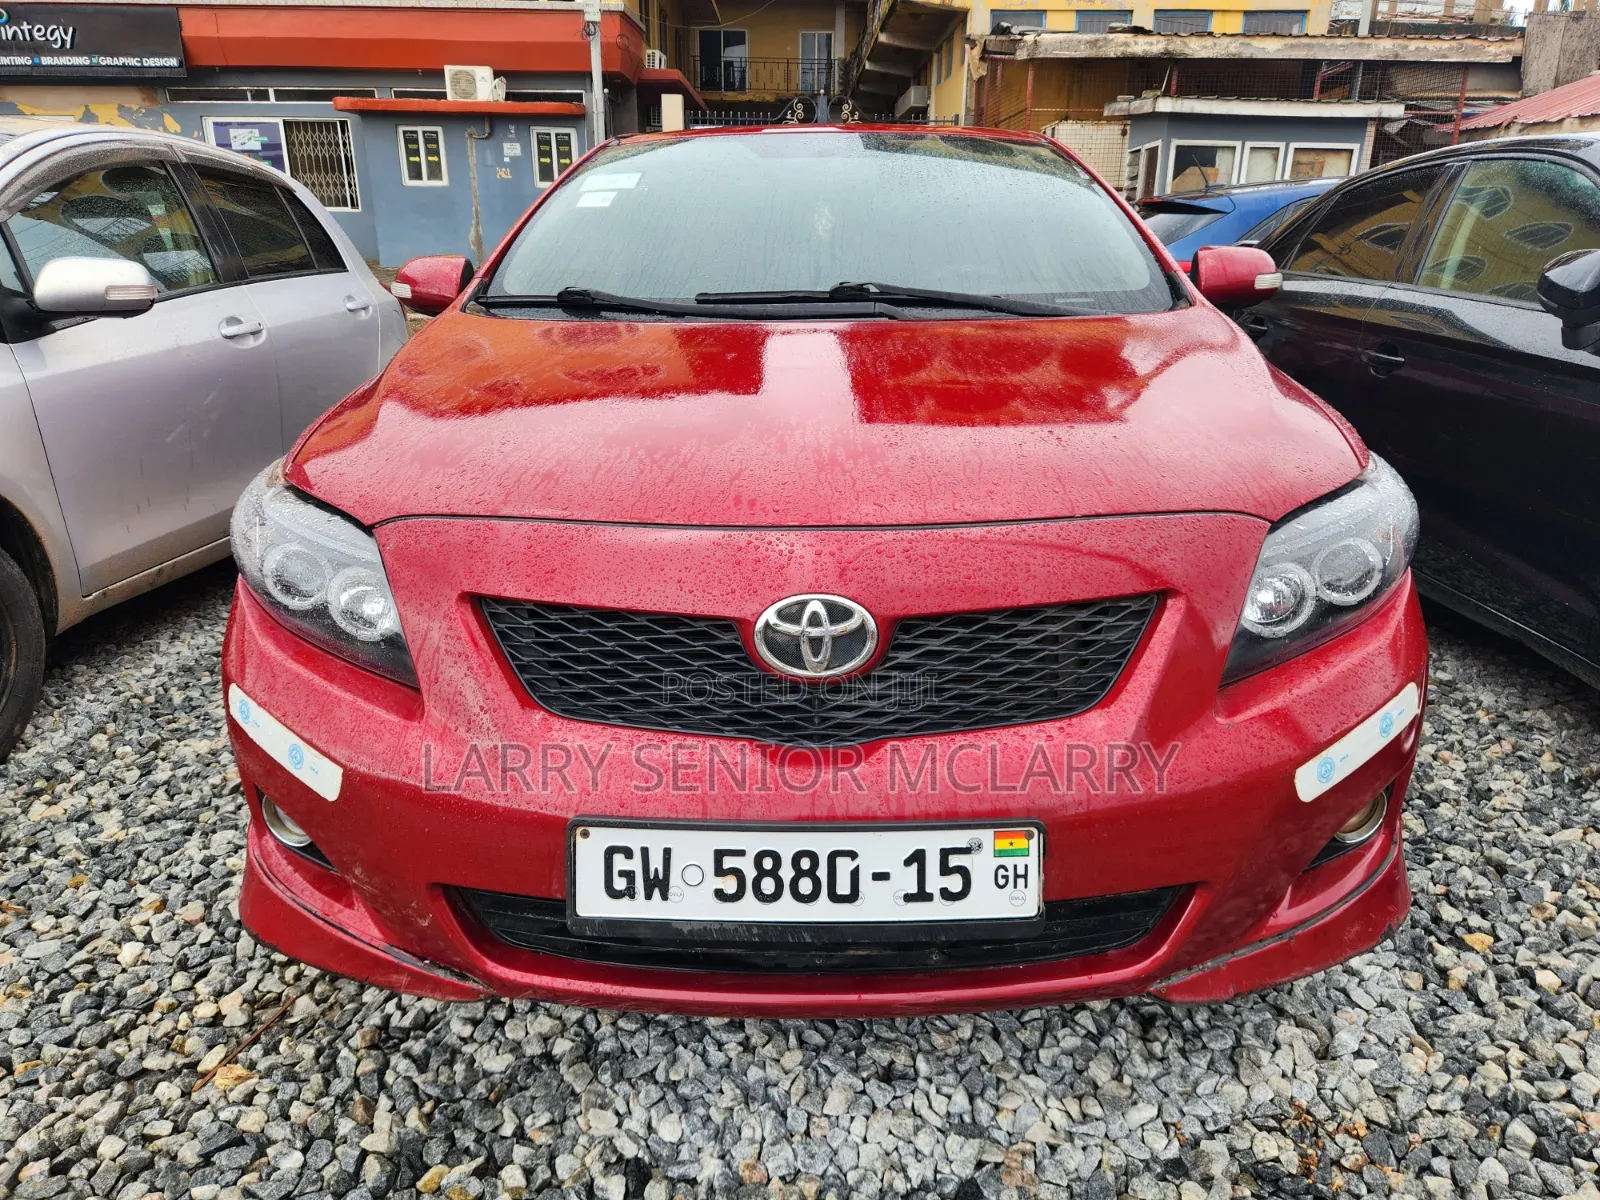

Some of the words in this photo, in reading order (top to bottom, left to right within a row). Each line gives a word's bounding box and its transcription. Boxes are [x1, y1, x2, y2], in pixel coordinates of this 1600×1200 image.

[0, 56, 32, 65] INTING
[41, 56, 90, 65] BRANDING
[99, 56, 141, 66] GRAPHIC
[142, 57, 177, 67] DESIGN
[603, 844, 672, 901] GW
[713, 847, 972, 904] 5880-15
[994, 863, 1029, 890] GH
